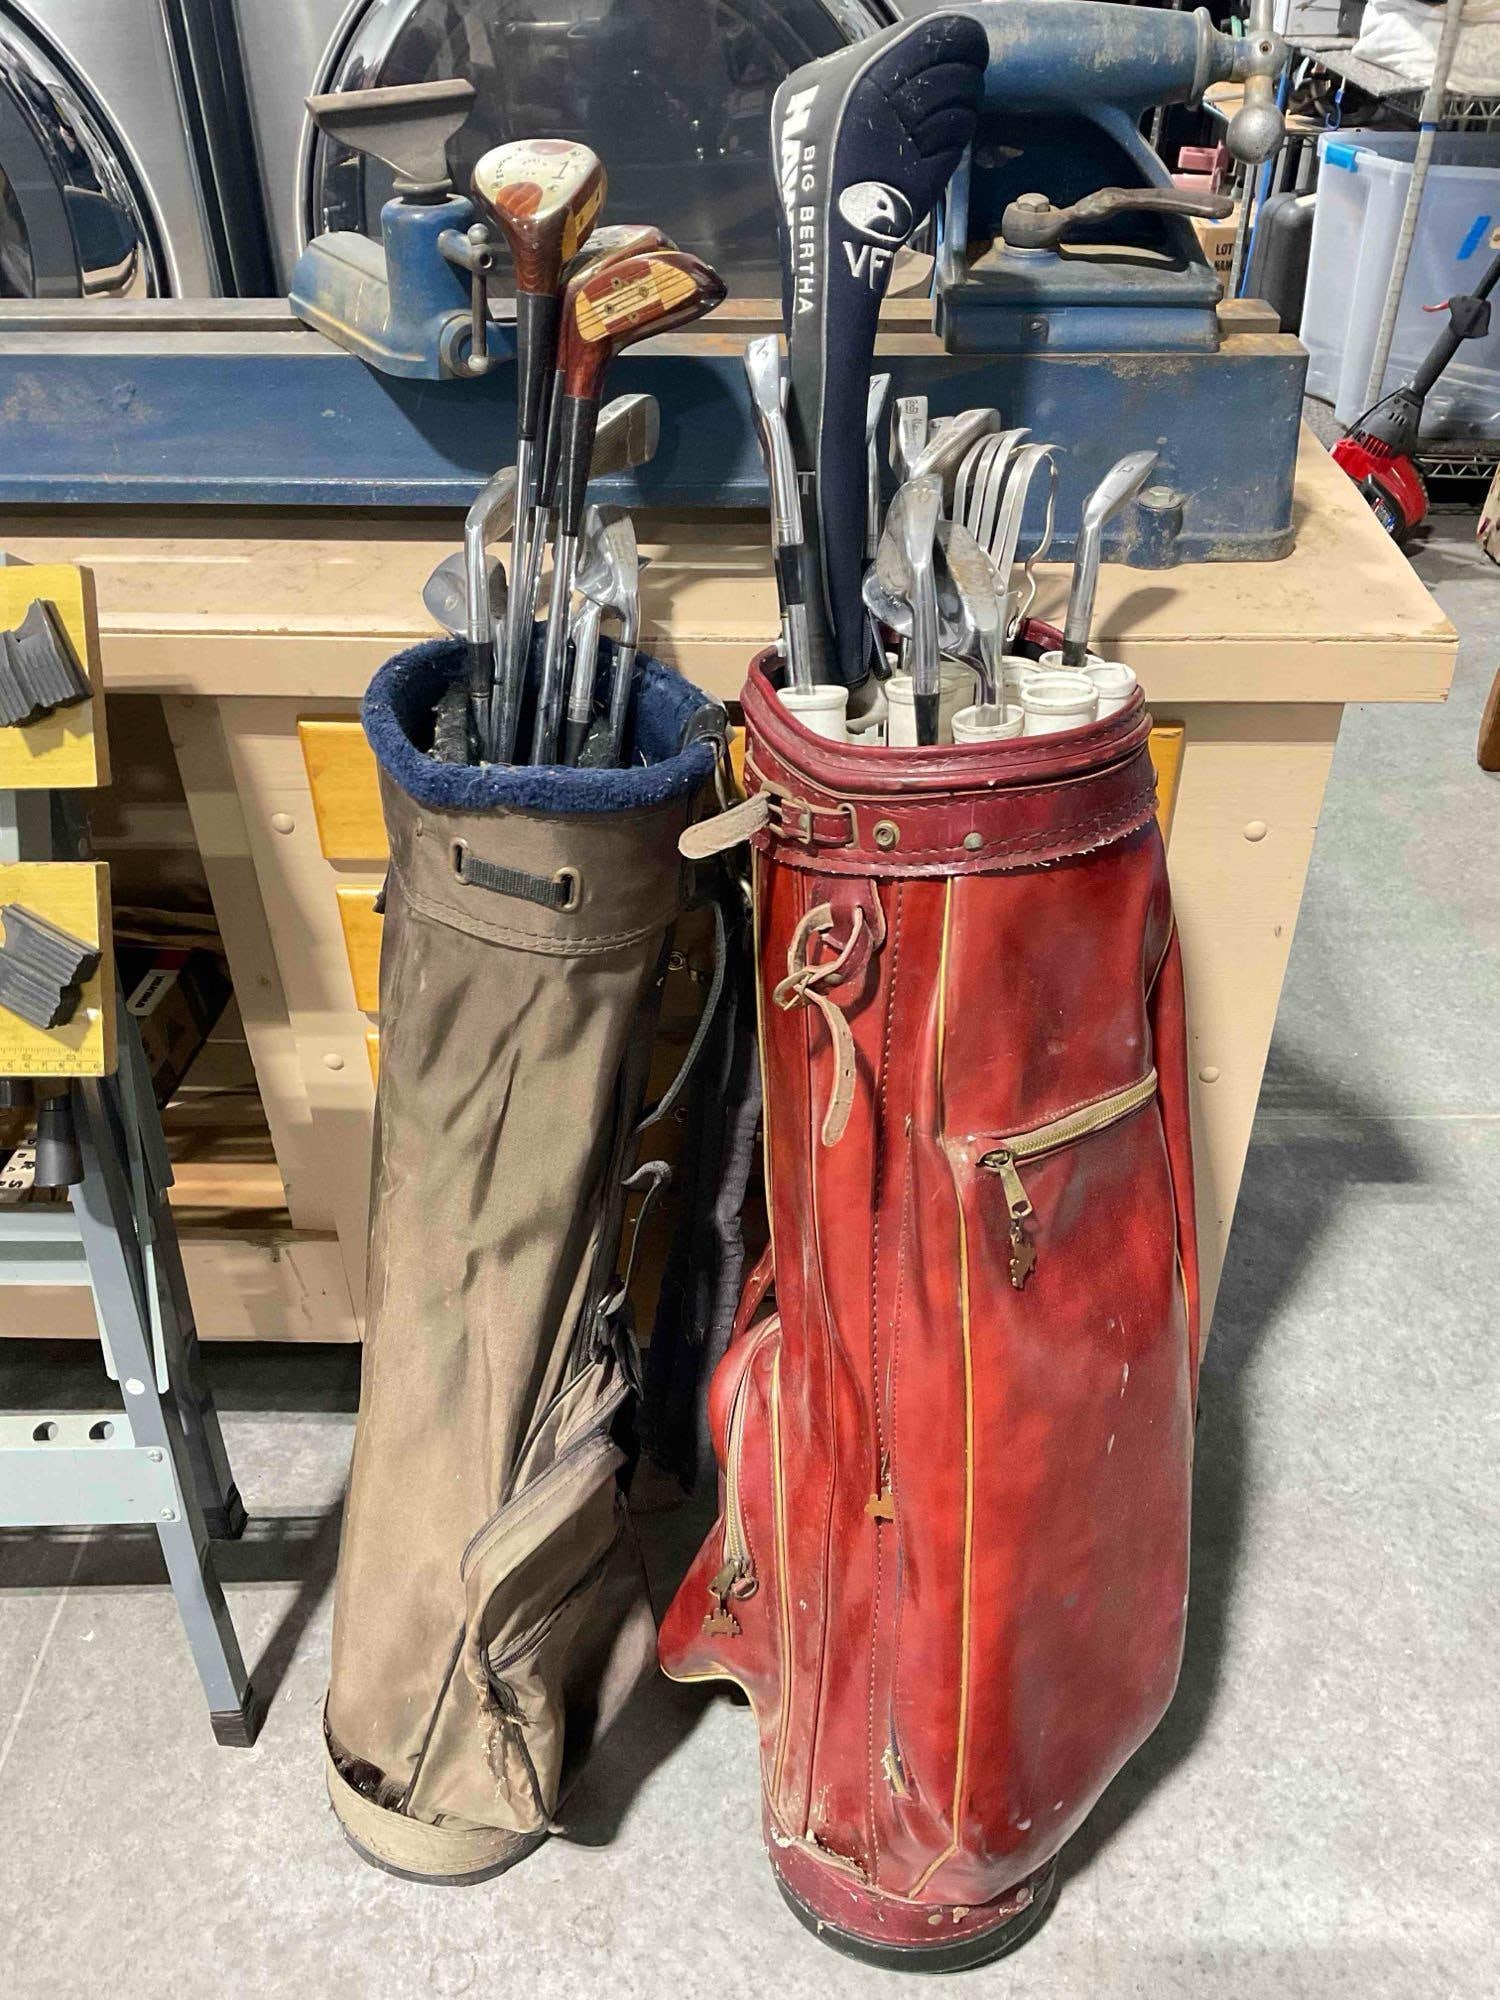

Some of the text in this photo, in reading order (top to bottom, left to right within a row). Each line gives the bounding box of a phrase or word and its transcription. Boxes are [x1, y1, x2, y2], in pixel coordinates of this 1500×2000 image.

[551, 160, 570, 180] 1
[798, 145, 816, 315] BIG BERTHA
[1216, 243, 1234, 256] LOT
